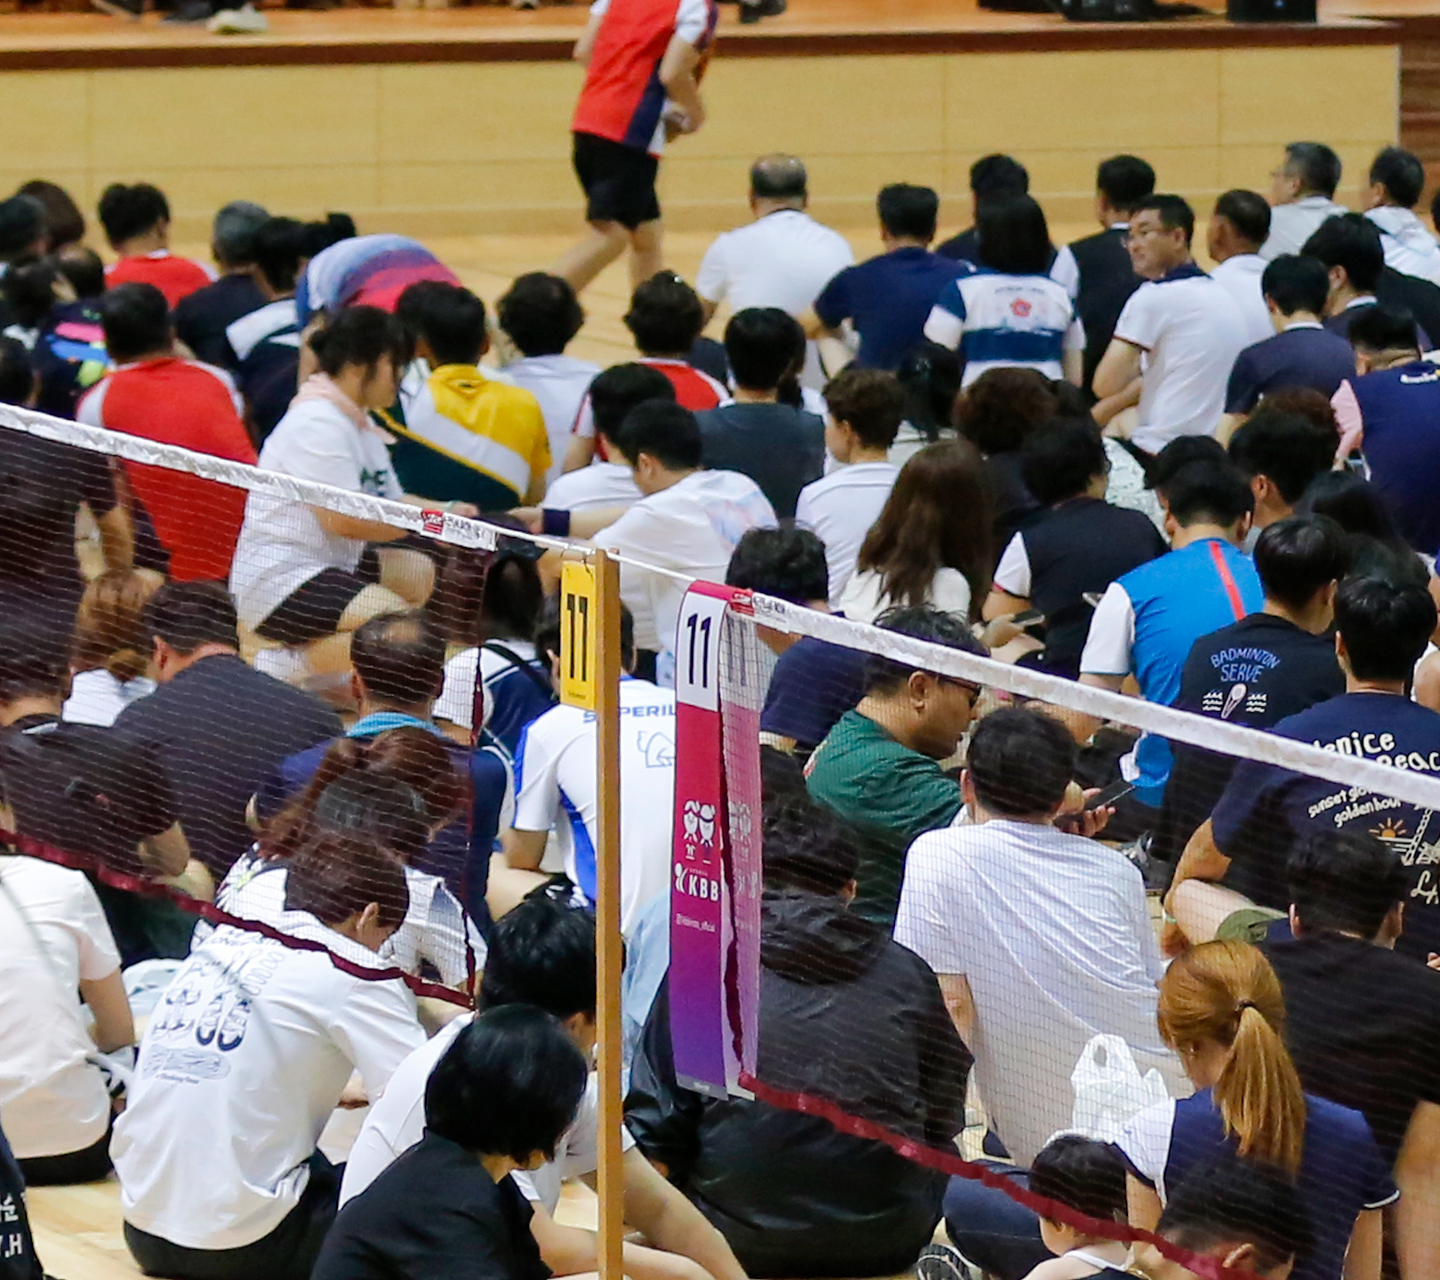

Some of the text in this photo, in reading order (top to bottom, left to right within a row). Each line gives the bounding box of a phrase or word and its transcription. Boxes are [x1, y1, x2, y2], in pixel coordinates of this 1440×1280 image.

[566, 591, 588, 681] 11
[686, 610, 714, 688] 11
[1210, 647, 1281, 670] BADMINTON
[1220, 663, 1266, 683] SERVE
